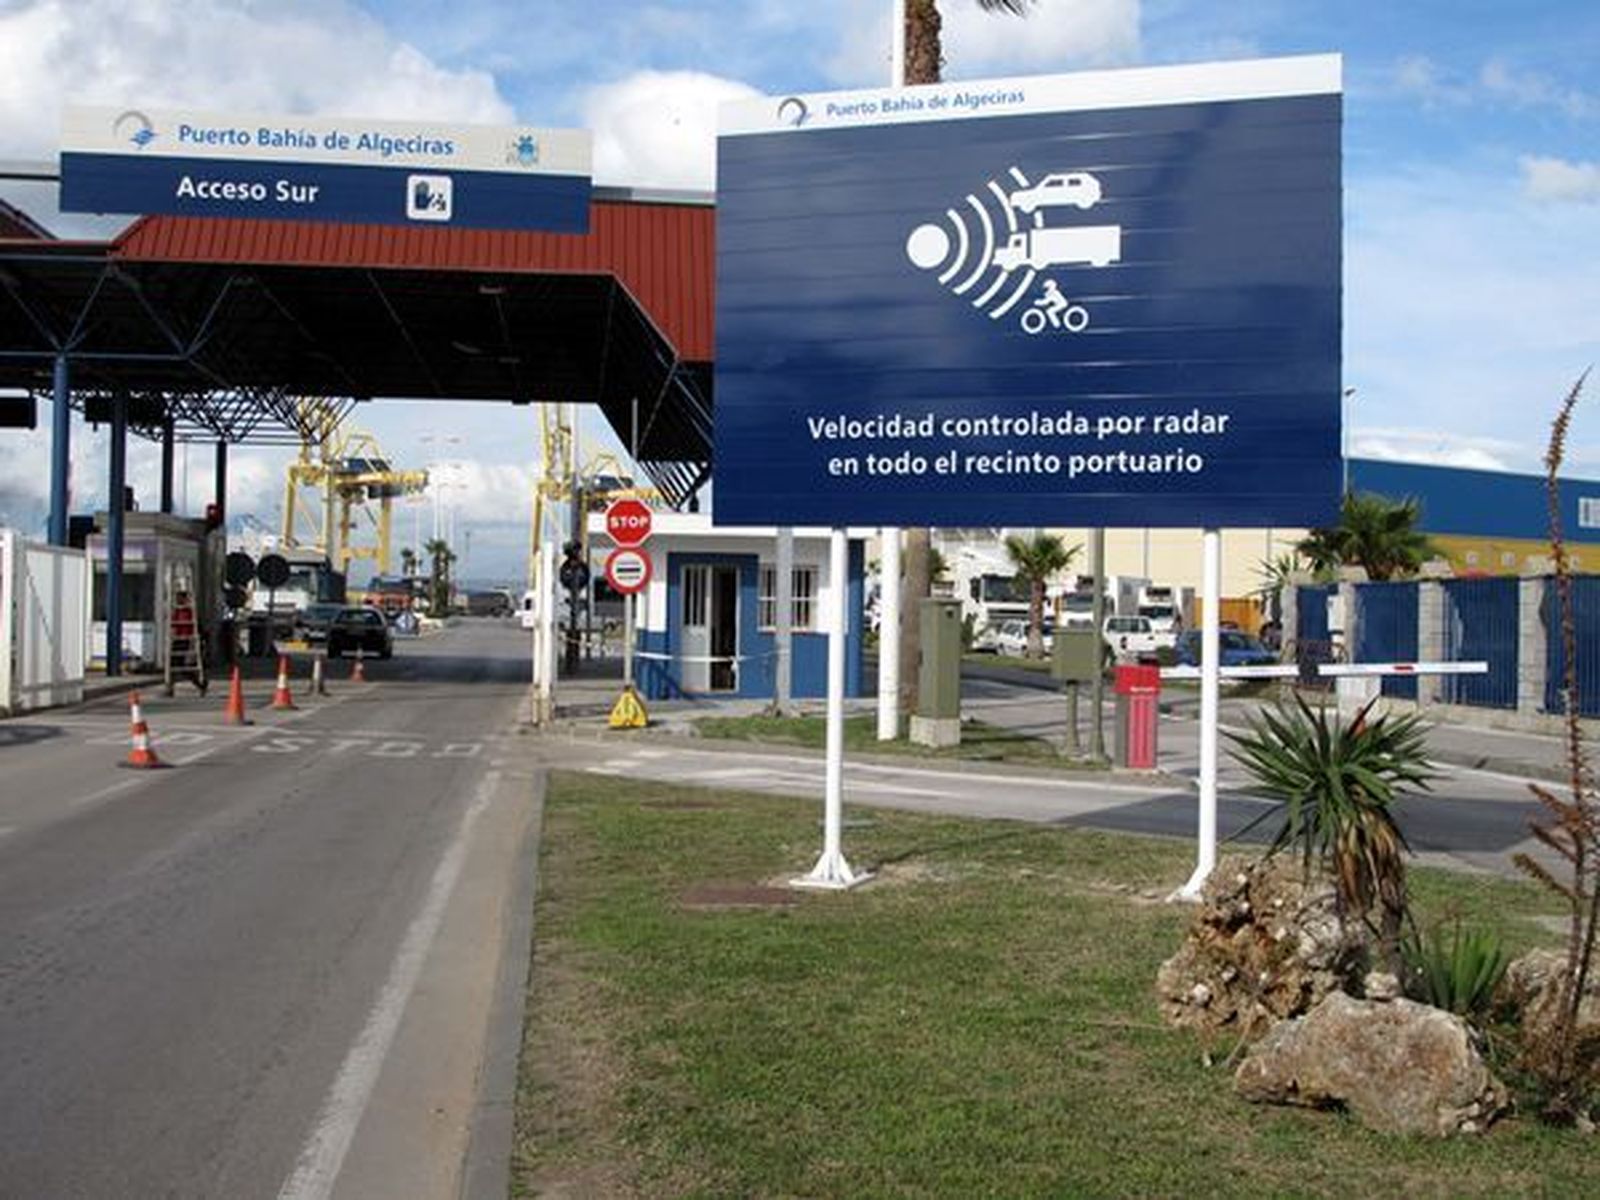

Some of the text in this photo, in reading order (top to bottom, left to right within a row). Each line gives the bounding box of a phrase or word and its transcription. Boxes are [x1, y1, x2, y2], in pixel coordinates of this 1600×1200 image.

[826, 101, 877, 117] Puerto
[928, 93, 949, 109] de
[953, 89, 1025, 108] Algeciras
[179, 124, 454, 156] Puerto Bahía de Algeciras
[177, 176, 320, 203] Acceso Sur
[808, 409, 1230, 440] Velocidad controlada por radar
[828, 448, 1204, 479] en todo el recinto portuario
[609, 515, 649, 529] STOP
